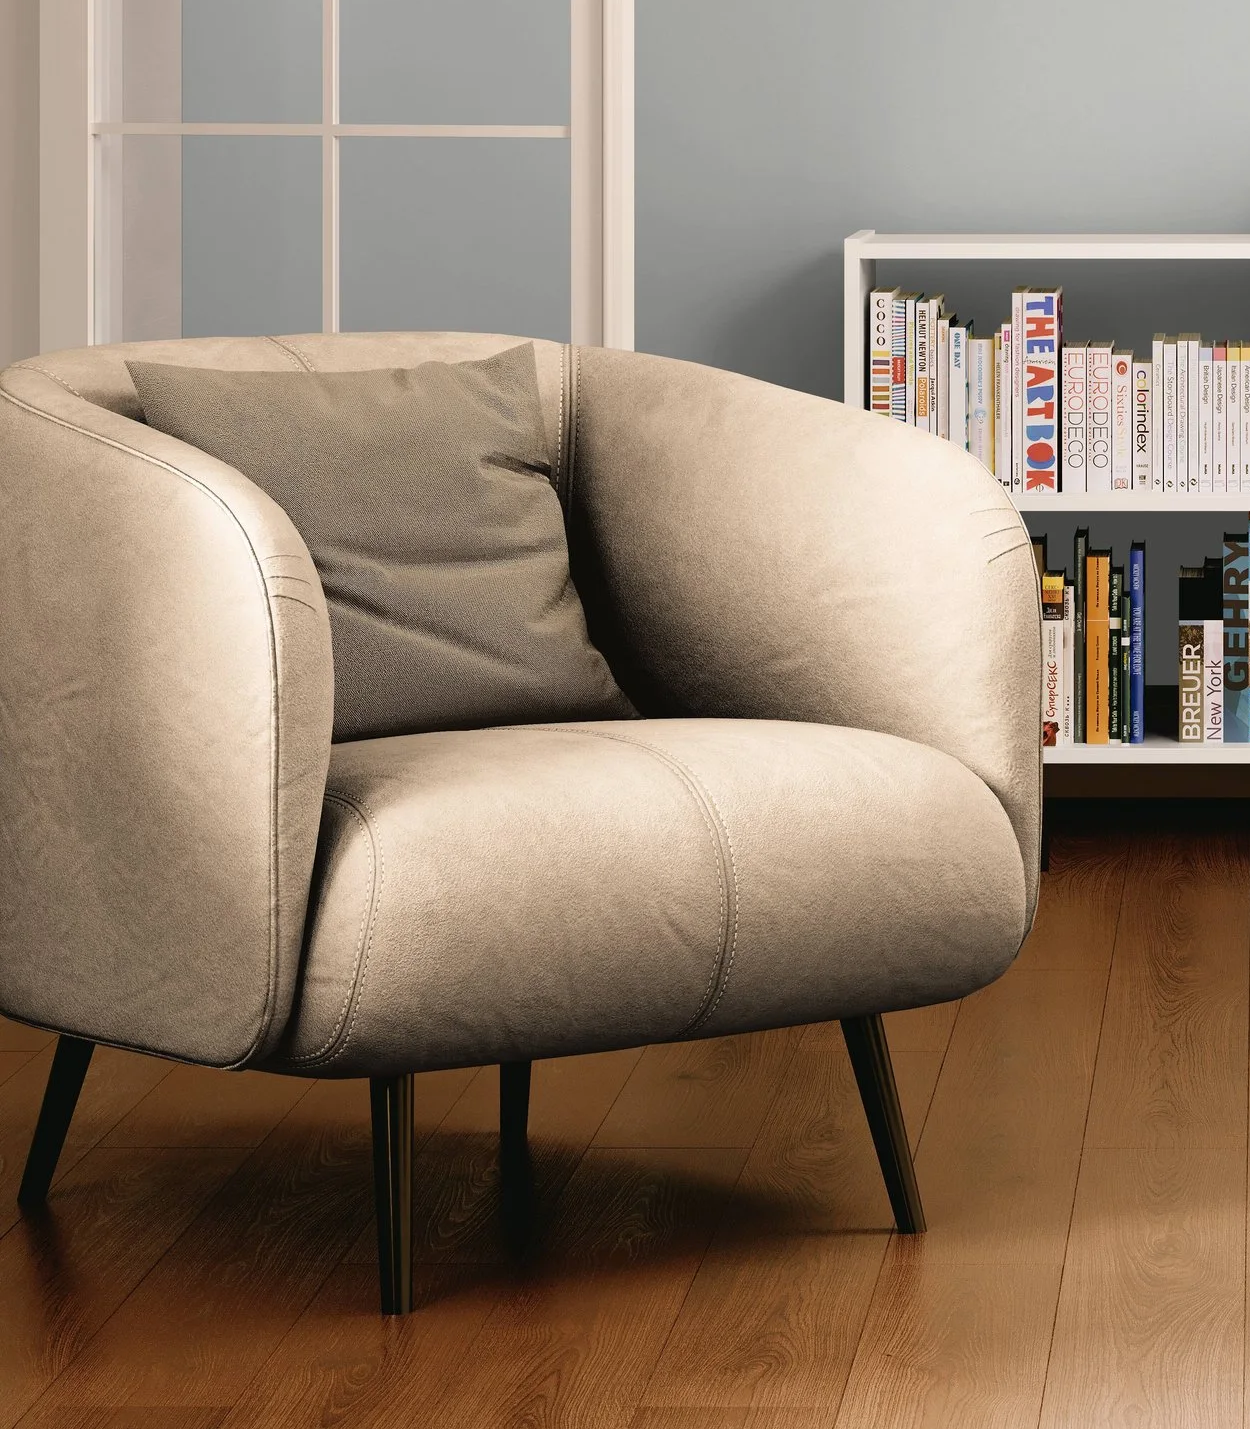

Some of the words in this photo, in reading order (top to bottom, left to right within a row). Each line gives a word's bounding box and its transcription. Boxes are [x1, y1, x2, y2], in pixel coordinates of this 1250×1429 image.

[918, 310, 926, 339] HELMUT
[1026, 296, 1055, 354] THE
[918, 341, 926, 372] NEWTON
[953, 352, 961, 369] DAY
[918, 378, 927, 416] Polaroids
[1026, 365, 1055, 420] ART
[1068, 353, 1084, 468] EURODECO
[1093, 353, 1108, 468] EURODECO
[1116, 384, 1128, 427] Sixties
[1137, 370, 1150, 453] colorindex
[1165, 376, 1174, 417] Storyboard
[1229, 383, 1237, 404] Design
[1178, 412, 1186, 439] Drawing
[1026, 424, 1055, 491] BOOK
[1223, 541, 1249, 692] GEHRY
[1046, 660, 1059, 718] СуперСЕКС
[1182, 643, 1201, 740] BREUER
[1206, 660, 1221, 697] York
[1206, 702, 1221, 741] New
